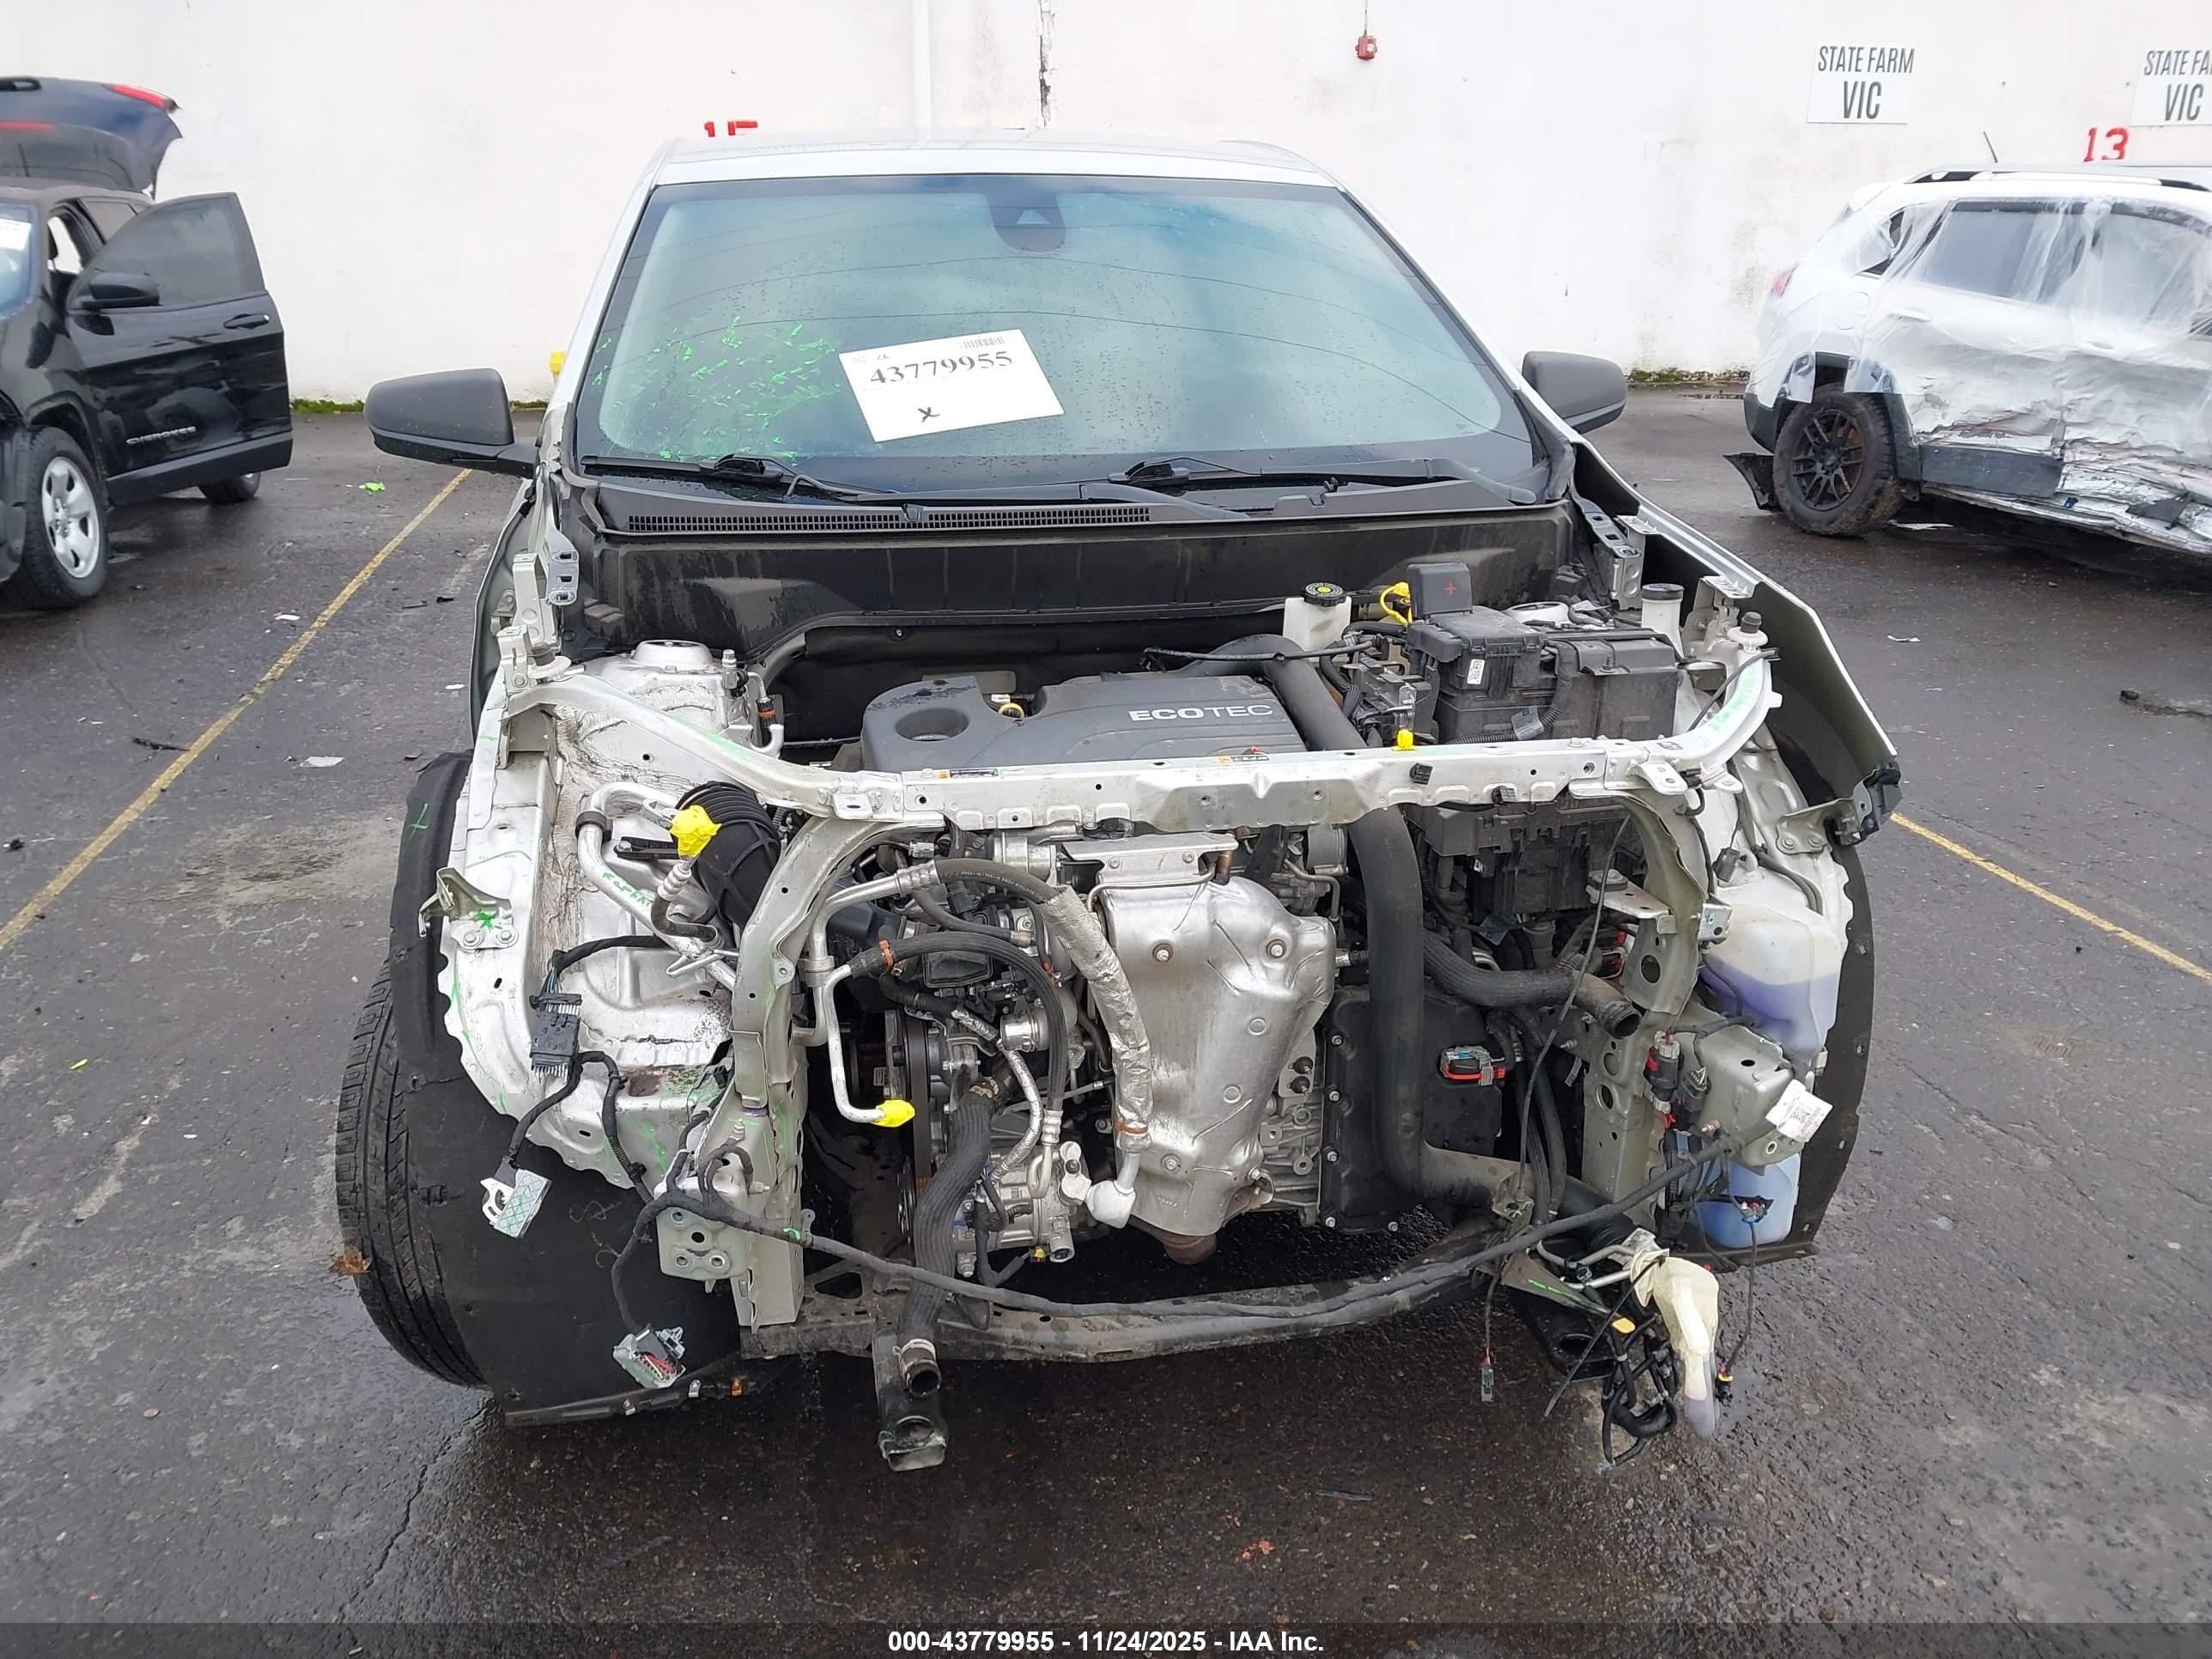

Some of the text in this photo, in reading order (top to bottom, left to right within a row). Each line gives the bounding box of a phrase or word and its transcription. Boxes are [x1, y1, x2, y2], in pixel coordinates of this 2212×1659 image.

[1818, 46, 1915, 73] STATE FARM
[2144, 50, 2212, 76] STATE FA
[1844, 81, 1882, 119] VIC
[2165, 84, 2204, 122] VIC
[2083, 127, 2130, 162] 13
[870, 350, 1012, 384] 43779955
[1128, 704, 1273, 721] ECOTEC
